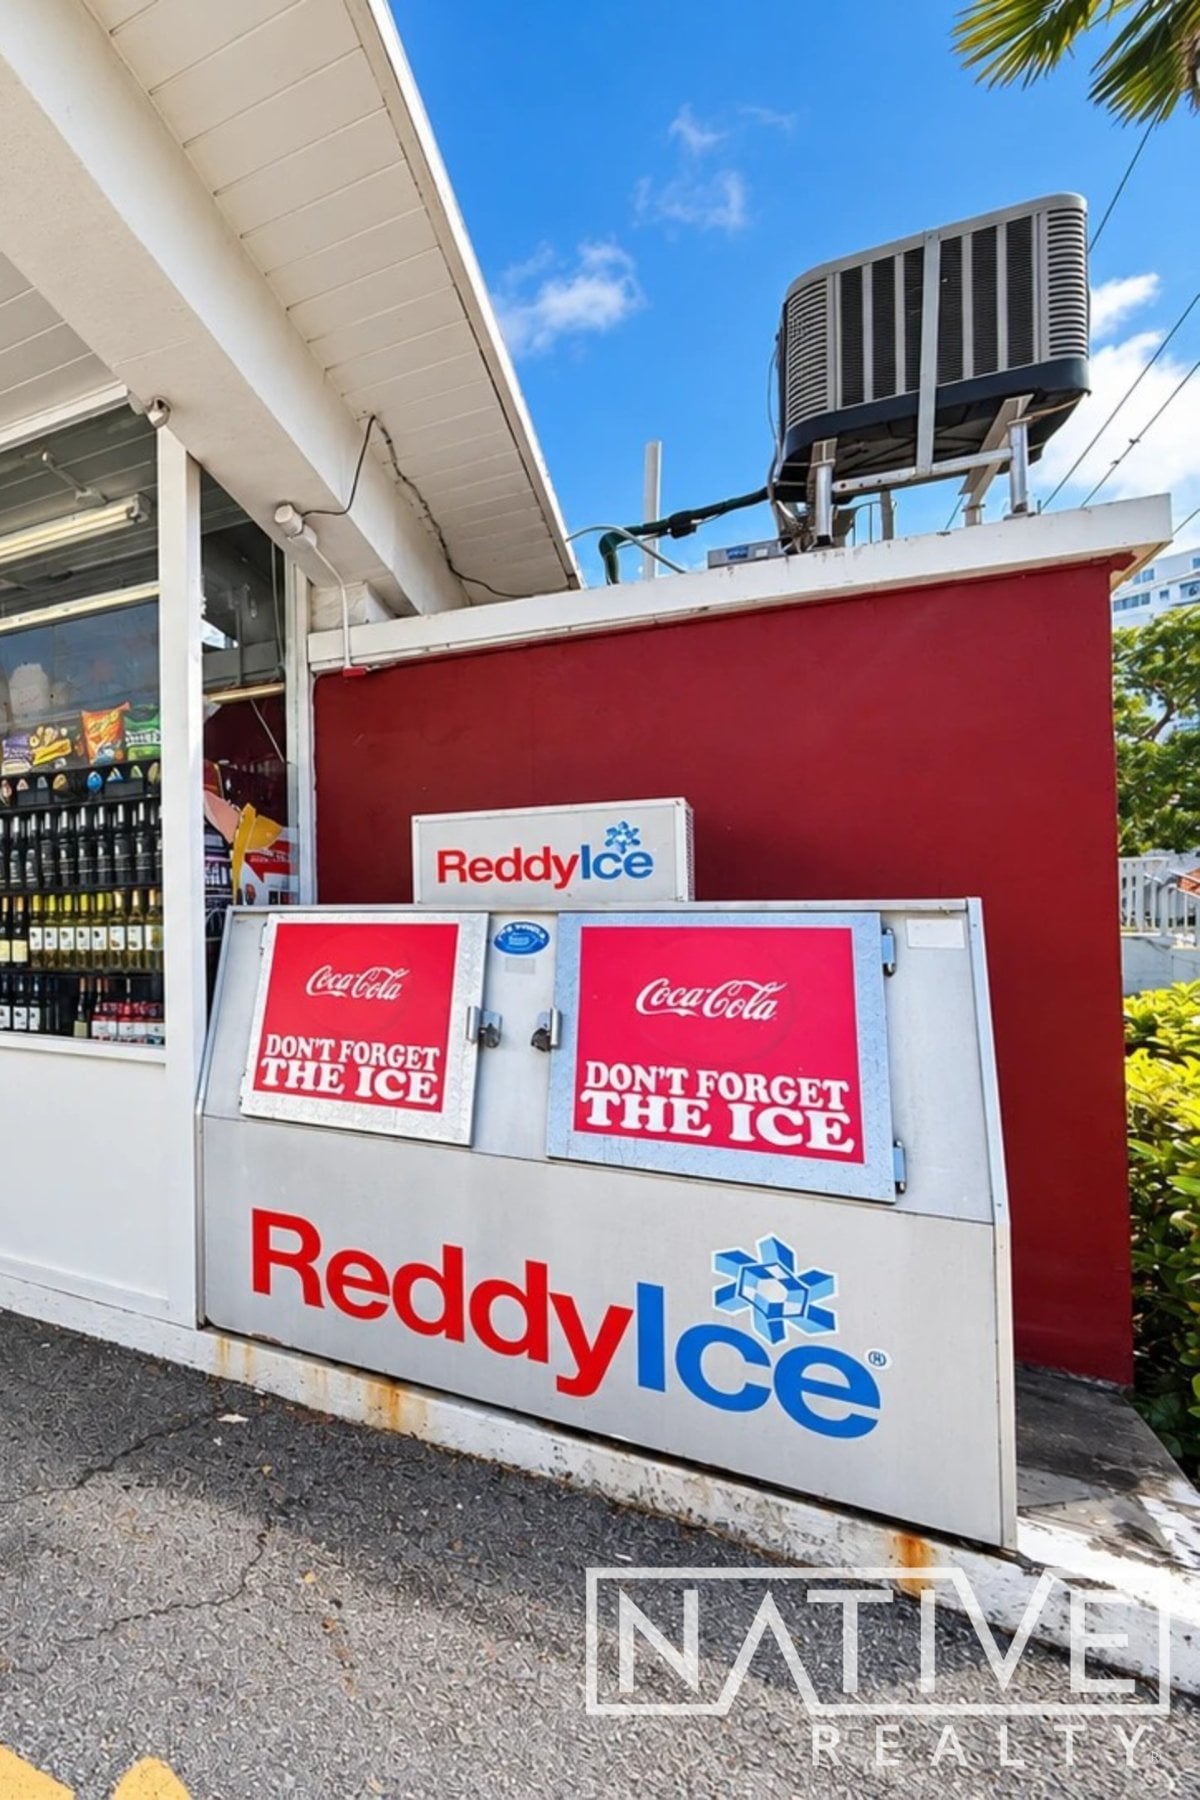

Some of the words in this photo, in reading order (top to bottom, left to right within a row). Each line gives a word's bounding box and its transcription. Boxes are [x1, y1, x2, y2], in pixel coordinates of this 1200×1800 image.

[265, 1034, 335, 1062] DON'T
[338, 1040, 440, 1072] FORGET
[260, 1057, 346, 1095] THE
[354, 1066, 439, 1105] ICE
[585, 1061, 689, 1096] DON'T
[696, 1070, 850, 1111] FORGET
[580, 1090, 712, 1138] THE
[727, 1103, 855, 1153] ICE
